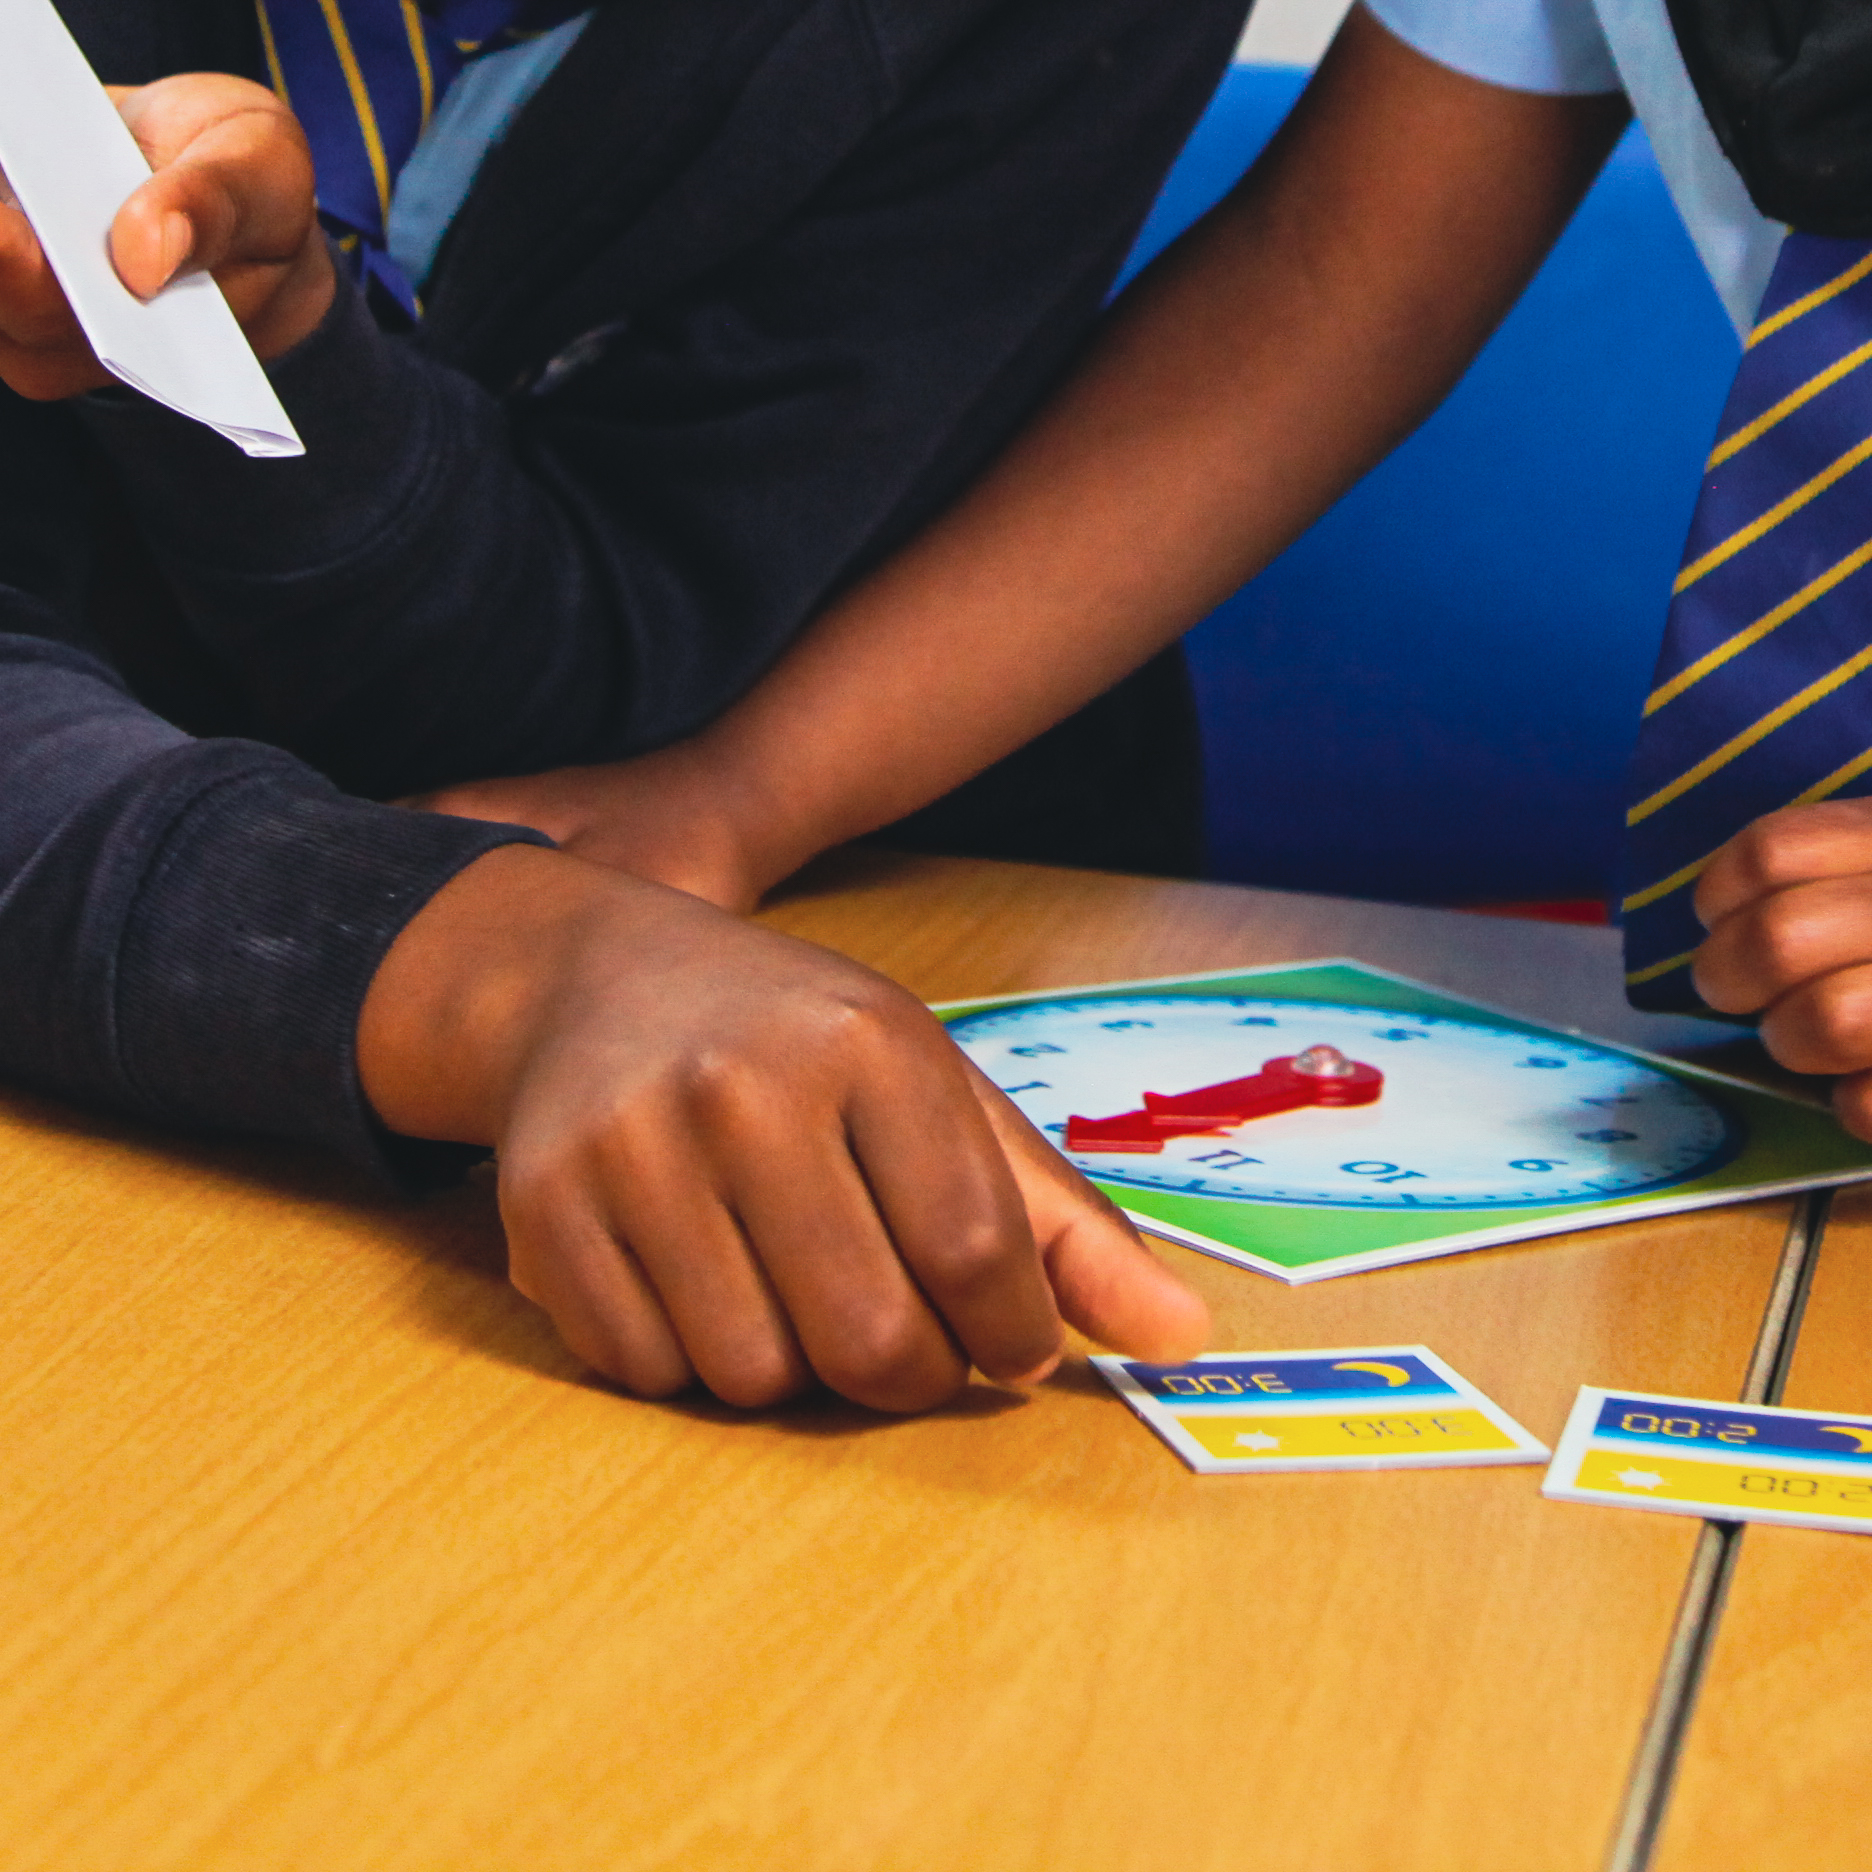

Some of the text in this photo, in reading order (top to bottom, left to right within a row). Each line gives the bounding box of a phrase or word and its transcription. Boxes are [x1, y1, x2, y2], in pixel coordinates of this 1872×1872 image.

[1339, 1158, 1428, 1186] 10
[1161, 1373, 1292, 1396] 3:00
[1340, 1416, 1472, 1441] 3:00
[1622, 1413, 1757, 1444] 2:00
